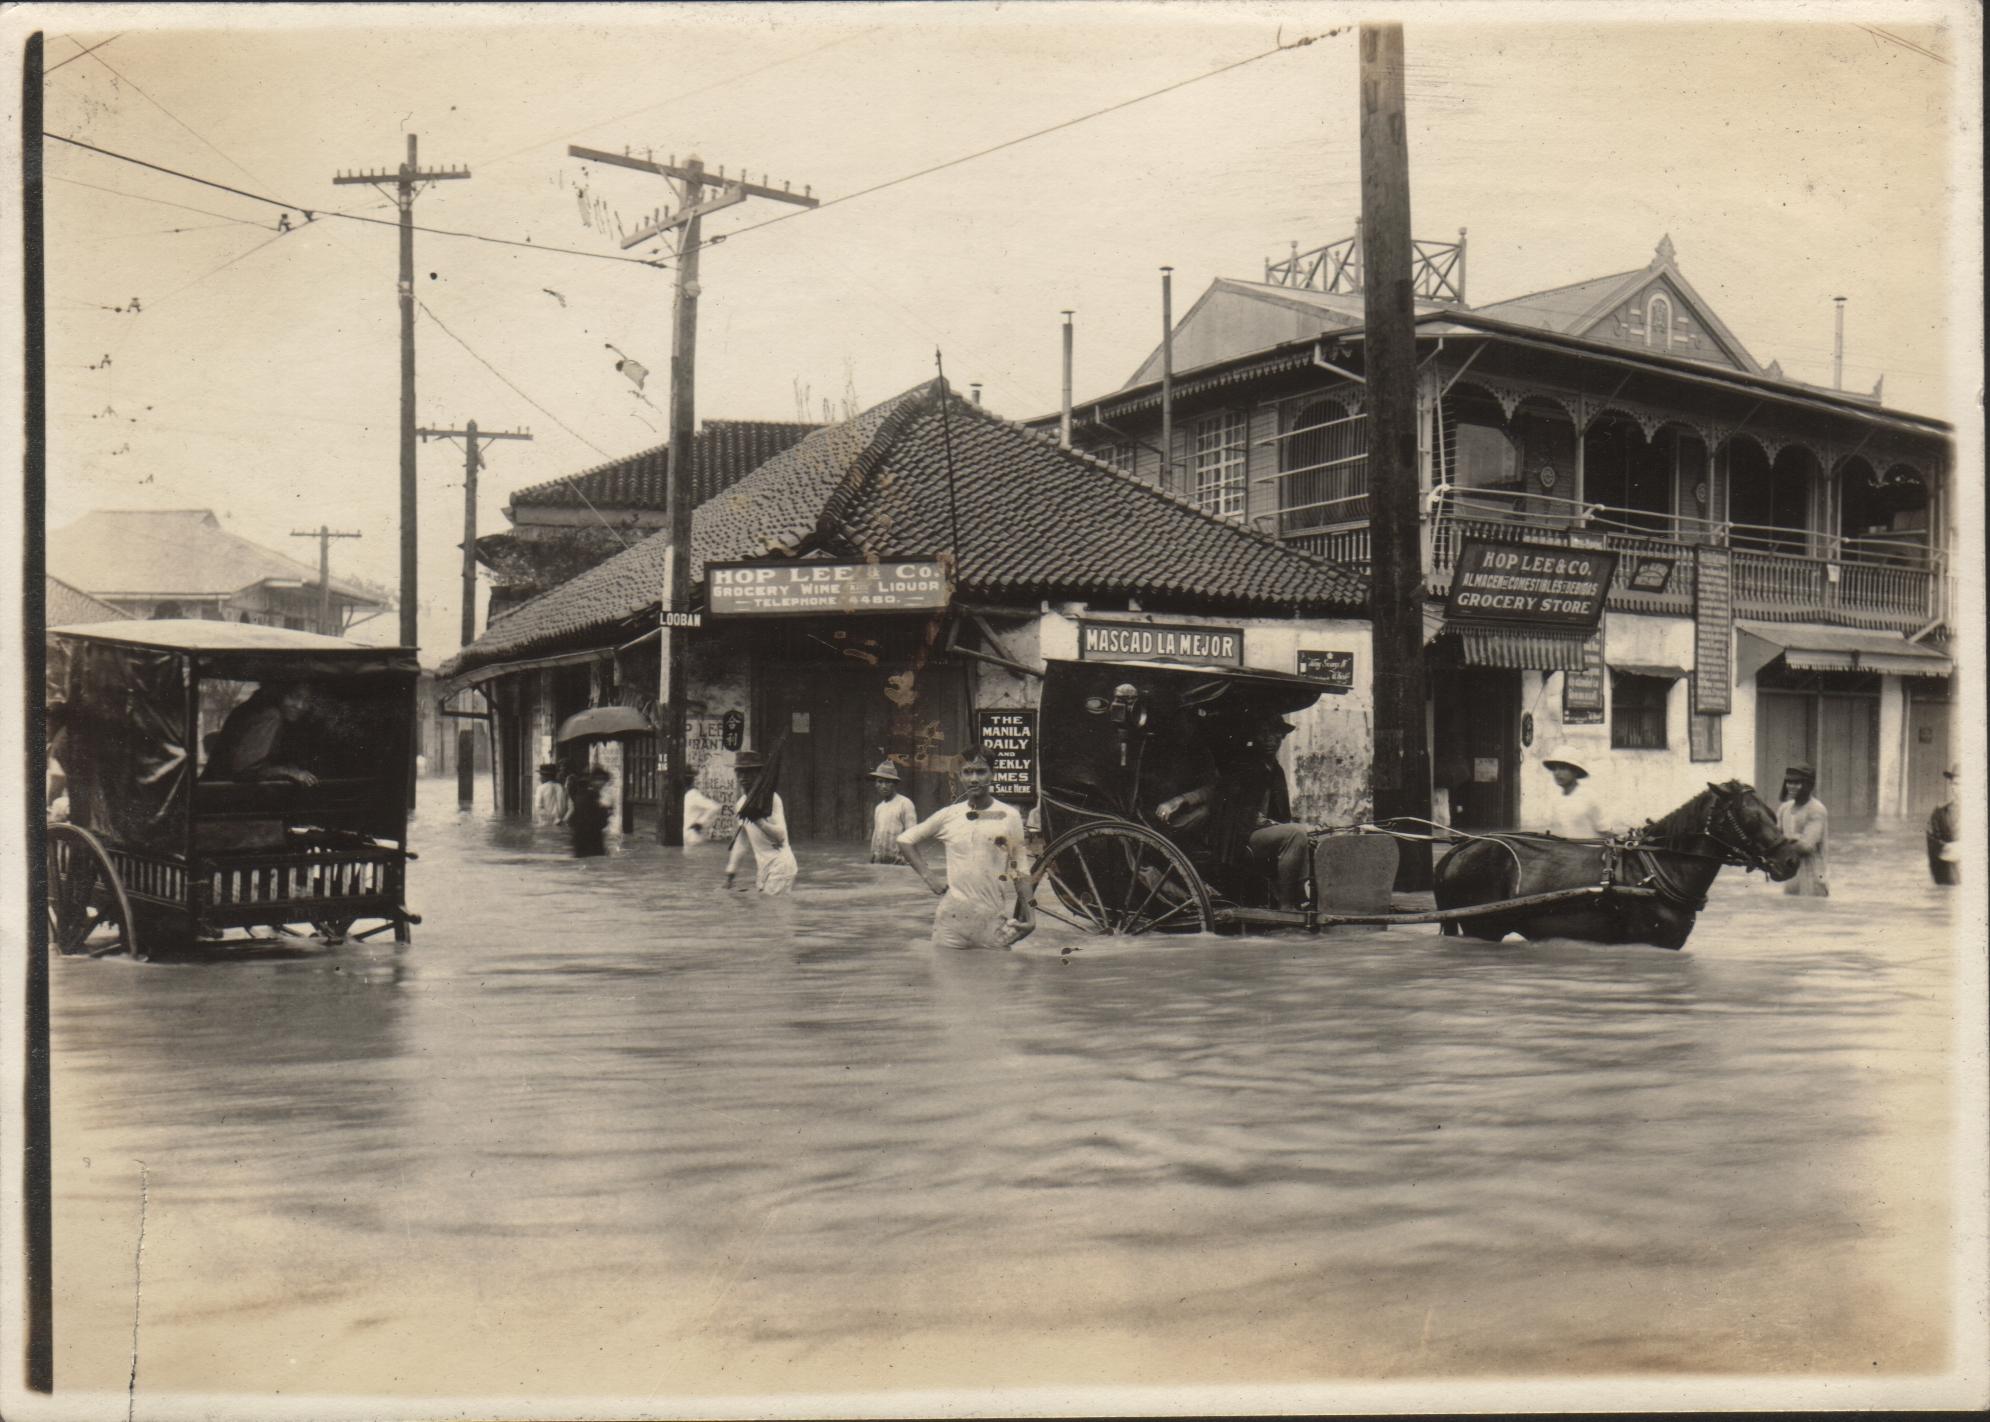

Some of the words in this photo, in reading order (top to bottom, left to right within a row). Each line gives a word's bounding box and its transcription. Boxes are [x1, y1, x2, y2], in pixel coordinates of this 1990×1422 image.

[1482, 551, 1518, 570] HOP
[714, 568, 776, 585] HOP
[789, 566, 854, 582] LEE
[1461, 572, 1504, 590] ALMACEN
[1508, 576, 1563, 594] COMESTIBLES
[712, 585, 790, 598] GROCERY
[800, 583, 841, 596] WINE
[878, 580, 939, 593] LIQUOR
[753, 597, 838, 608] TELEPHONE
[1457, 592, 1538, 610] GROCERY
[1540, 598, 1592, 615] STORE
[659, 612, 702, 627] LOOBAN
[1086, 628, 1153, 653] MASCAD
[1156, 632, 1176, 655] LA
[1179, 634, 1234, 657] MEJOR
[990, 716, 1023, 725] THE
[982, 726, 1032, 737] MANILA
[984, 739, 1029, 749] DAILY
[993, 759, 1031, 769] EEKLY
[993, 772, 1029, 782] IMES
